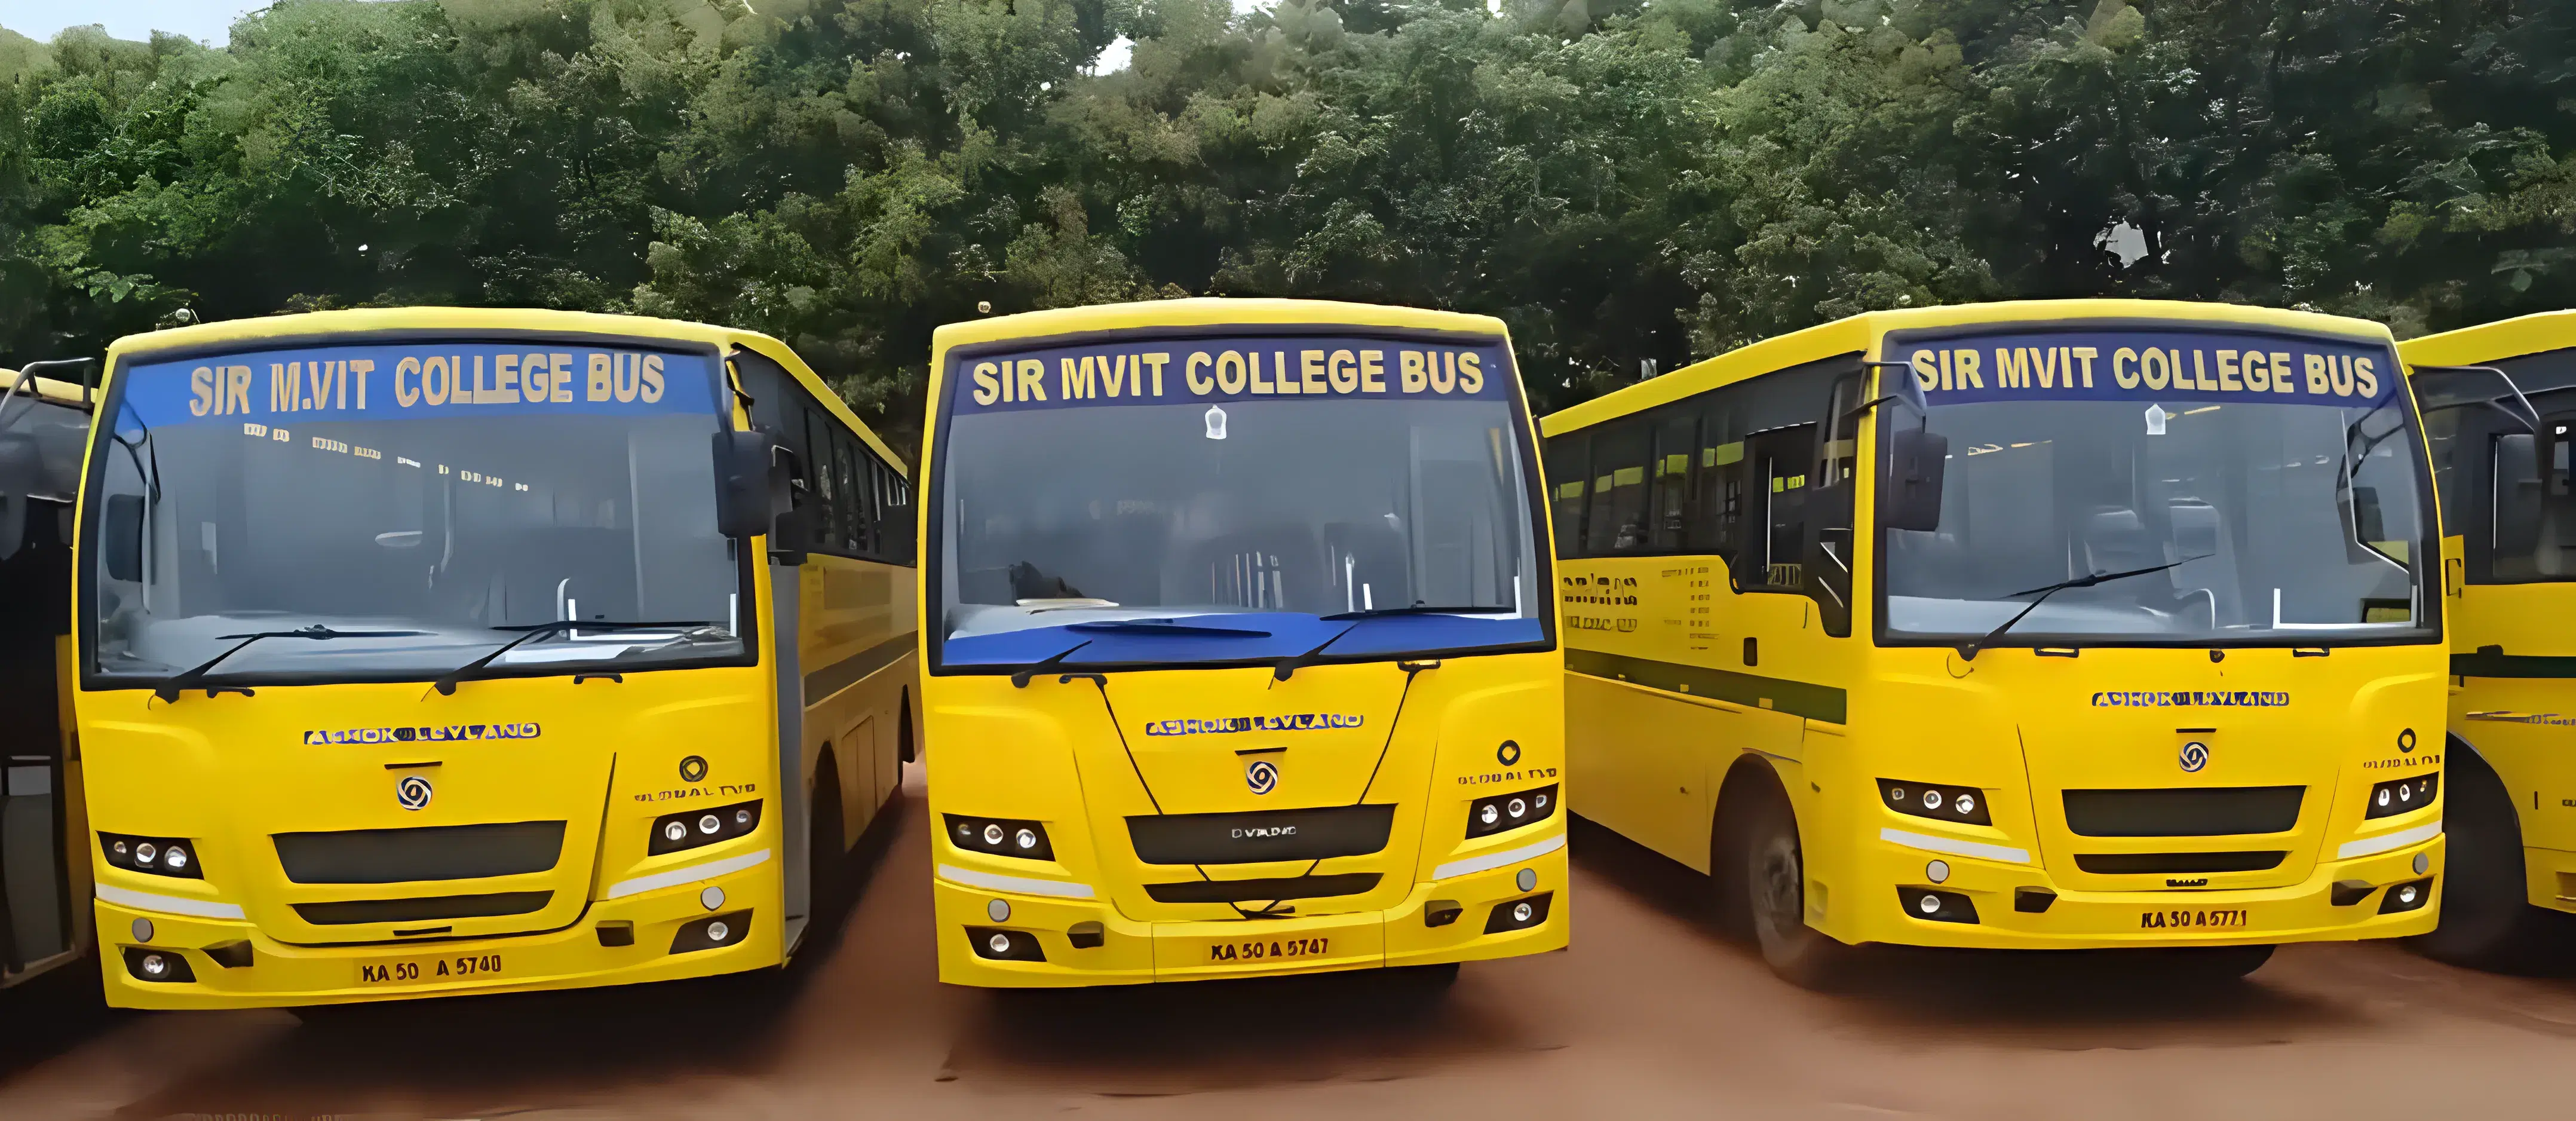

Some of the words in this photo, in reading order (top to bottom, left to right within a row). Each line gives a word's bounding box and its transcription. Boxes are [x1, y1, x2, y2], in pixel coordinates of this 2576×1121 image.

[190, 366, 252, 416] SIR
[270, 360, 375, 412] M.VIT
[395, 353, 572, 407] COLLEGE
[587, 353, 664, 403] BUS
[973, 359, 1047, 405] SIR
[1060, 352, 1170, 400] MVIT
[1186, 350, 1386, 395] COLLEGE
[1400, 350, 1484, 394] BUS
[1912, 349, 1984, 391] SIR
[1996, 347, 2099, 388] MVIT
[2113, 347, 2296, 393] COLLEGE
[2305, 354, 2378, 399] BUS
[2141, 912, 2166, 928] KA
[2170, 911, 2191, 927] 50
[2195, 911, 2206, 926] A
[1211, 944, 1238, 960] KA
[1242, 942, 1264, 959] 50
[1269, 941, 1283, 957] A
[362, 964, 391, 982] KA
[396, 962, 419, 981] 50
[436, 959, 450, 976] A
